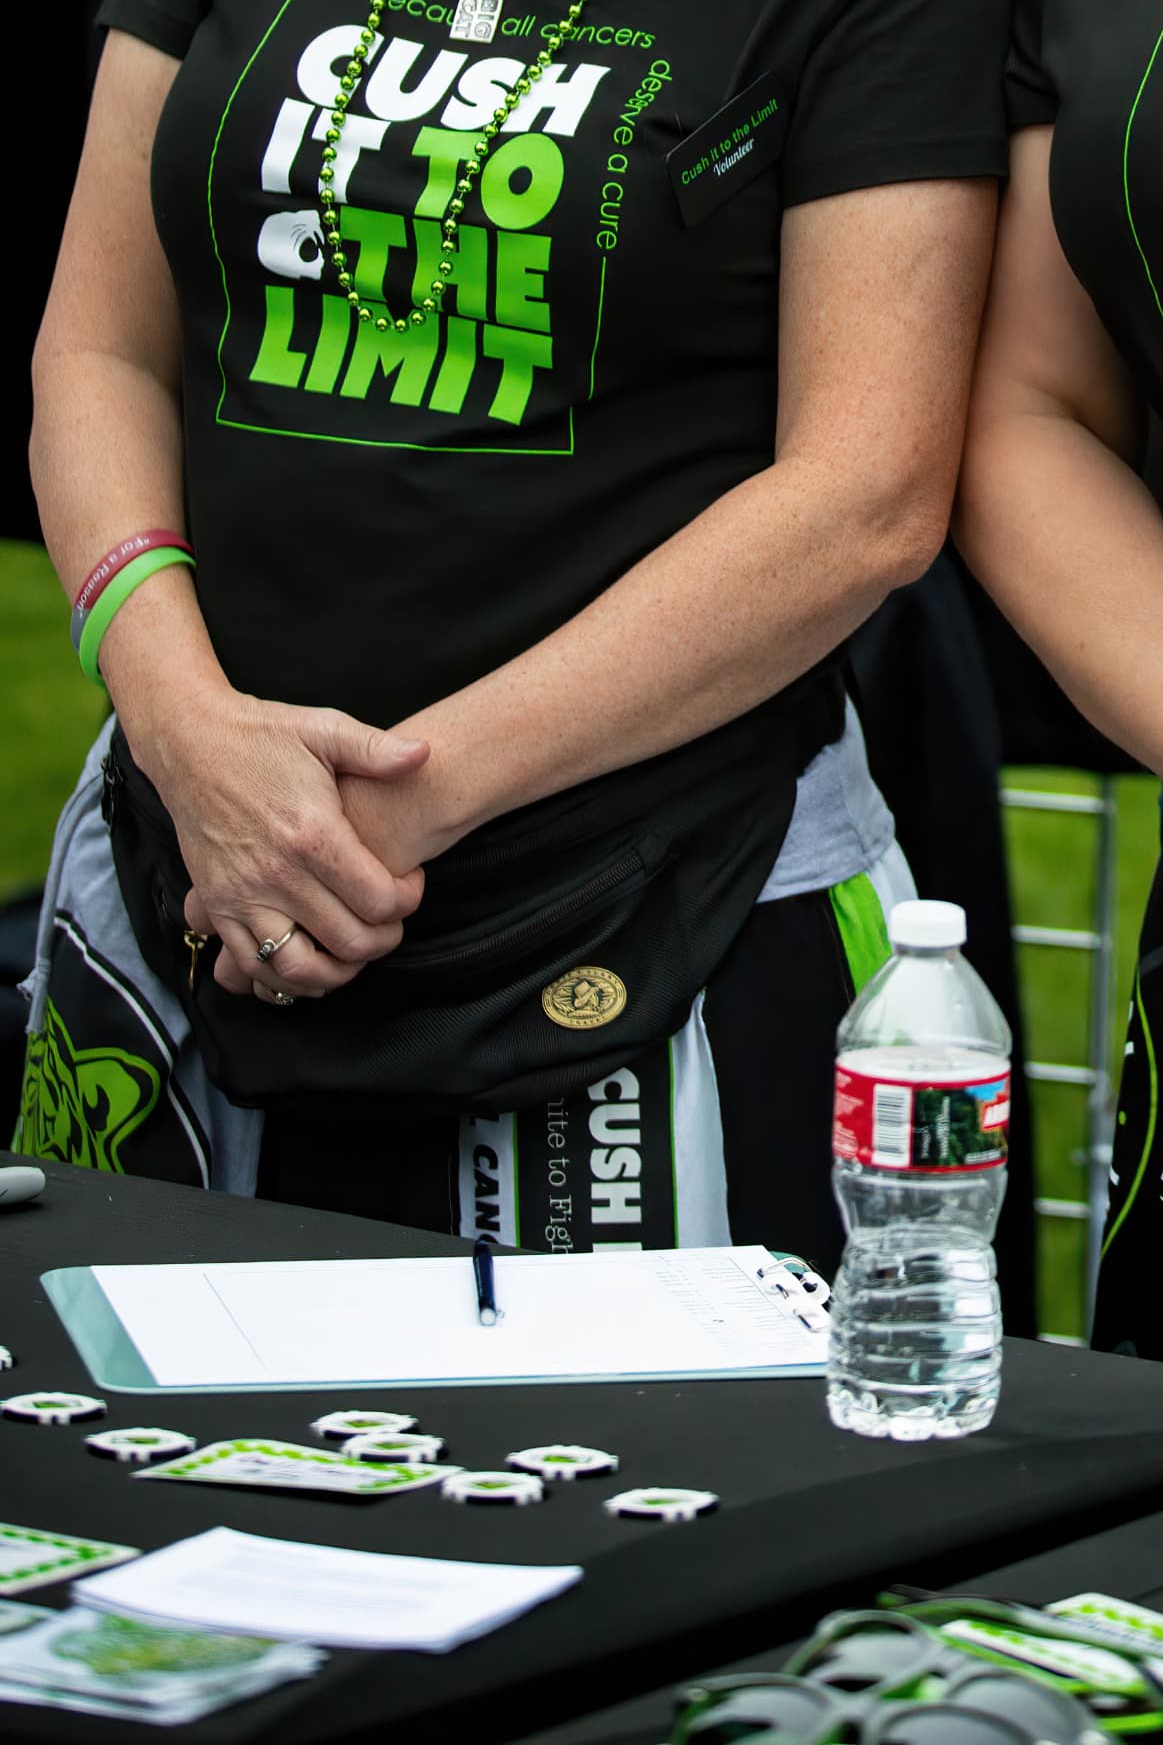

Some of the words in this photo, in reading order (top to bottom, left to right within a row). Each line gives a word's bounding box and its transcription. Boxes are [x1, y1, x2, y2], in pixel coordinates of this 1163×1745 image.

[501, 15, 536, 37] all
[297, 25, 611, 137] CUSH
[261, 97, 391, 204] IT
[411, 126, 565, 230] TO
[607, 153, 629, 174] a
[681, 155, 710, 185] Cush
[720, 138, 731, 155] to
[733, 124, 751, 145] the
[750, 99, 779, 128] Limit
[713, 138, 755, 177] Volunteer
[596, 182, 624, 250] cure
[339, 206, 553, 334] THE
[248, 285, 554, 426] LIMIT
[548, 1098, 568, 1149] nite
[588, 1067, 642, 1223] CUSH
[548, 1156, 571, 1187] to
[545, 1195, 573, 1254] Figh
